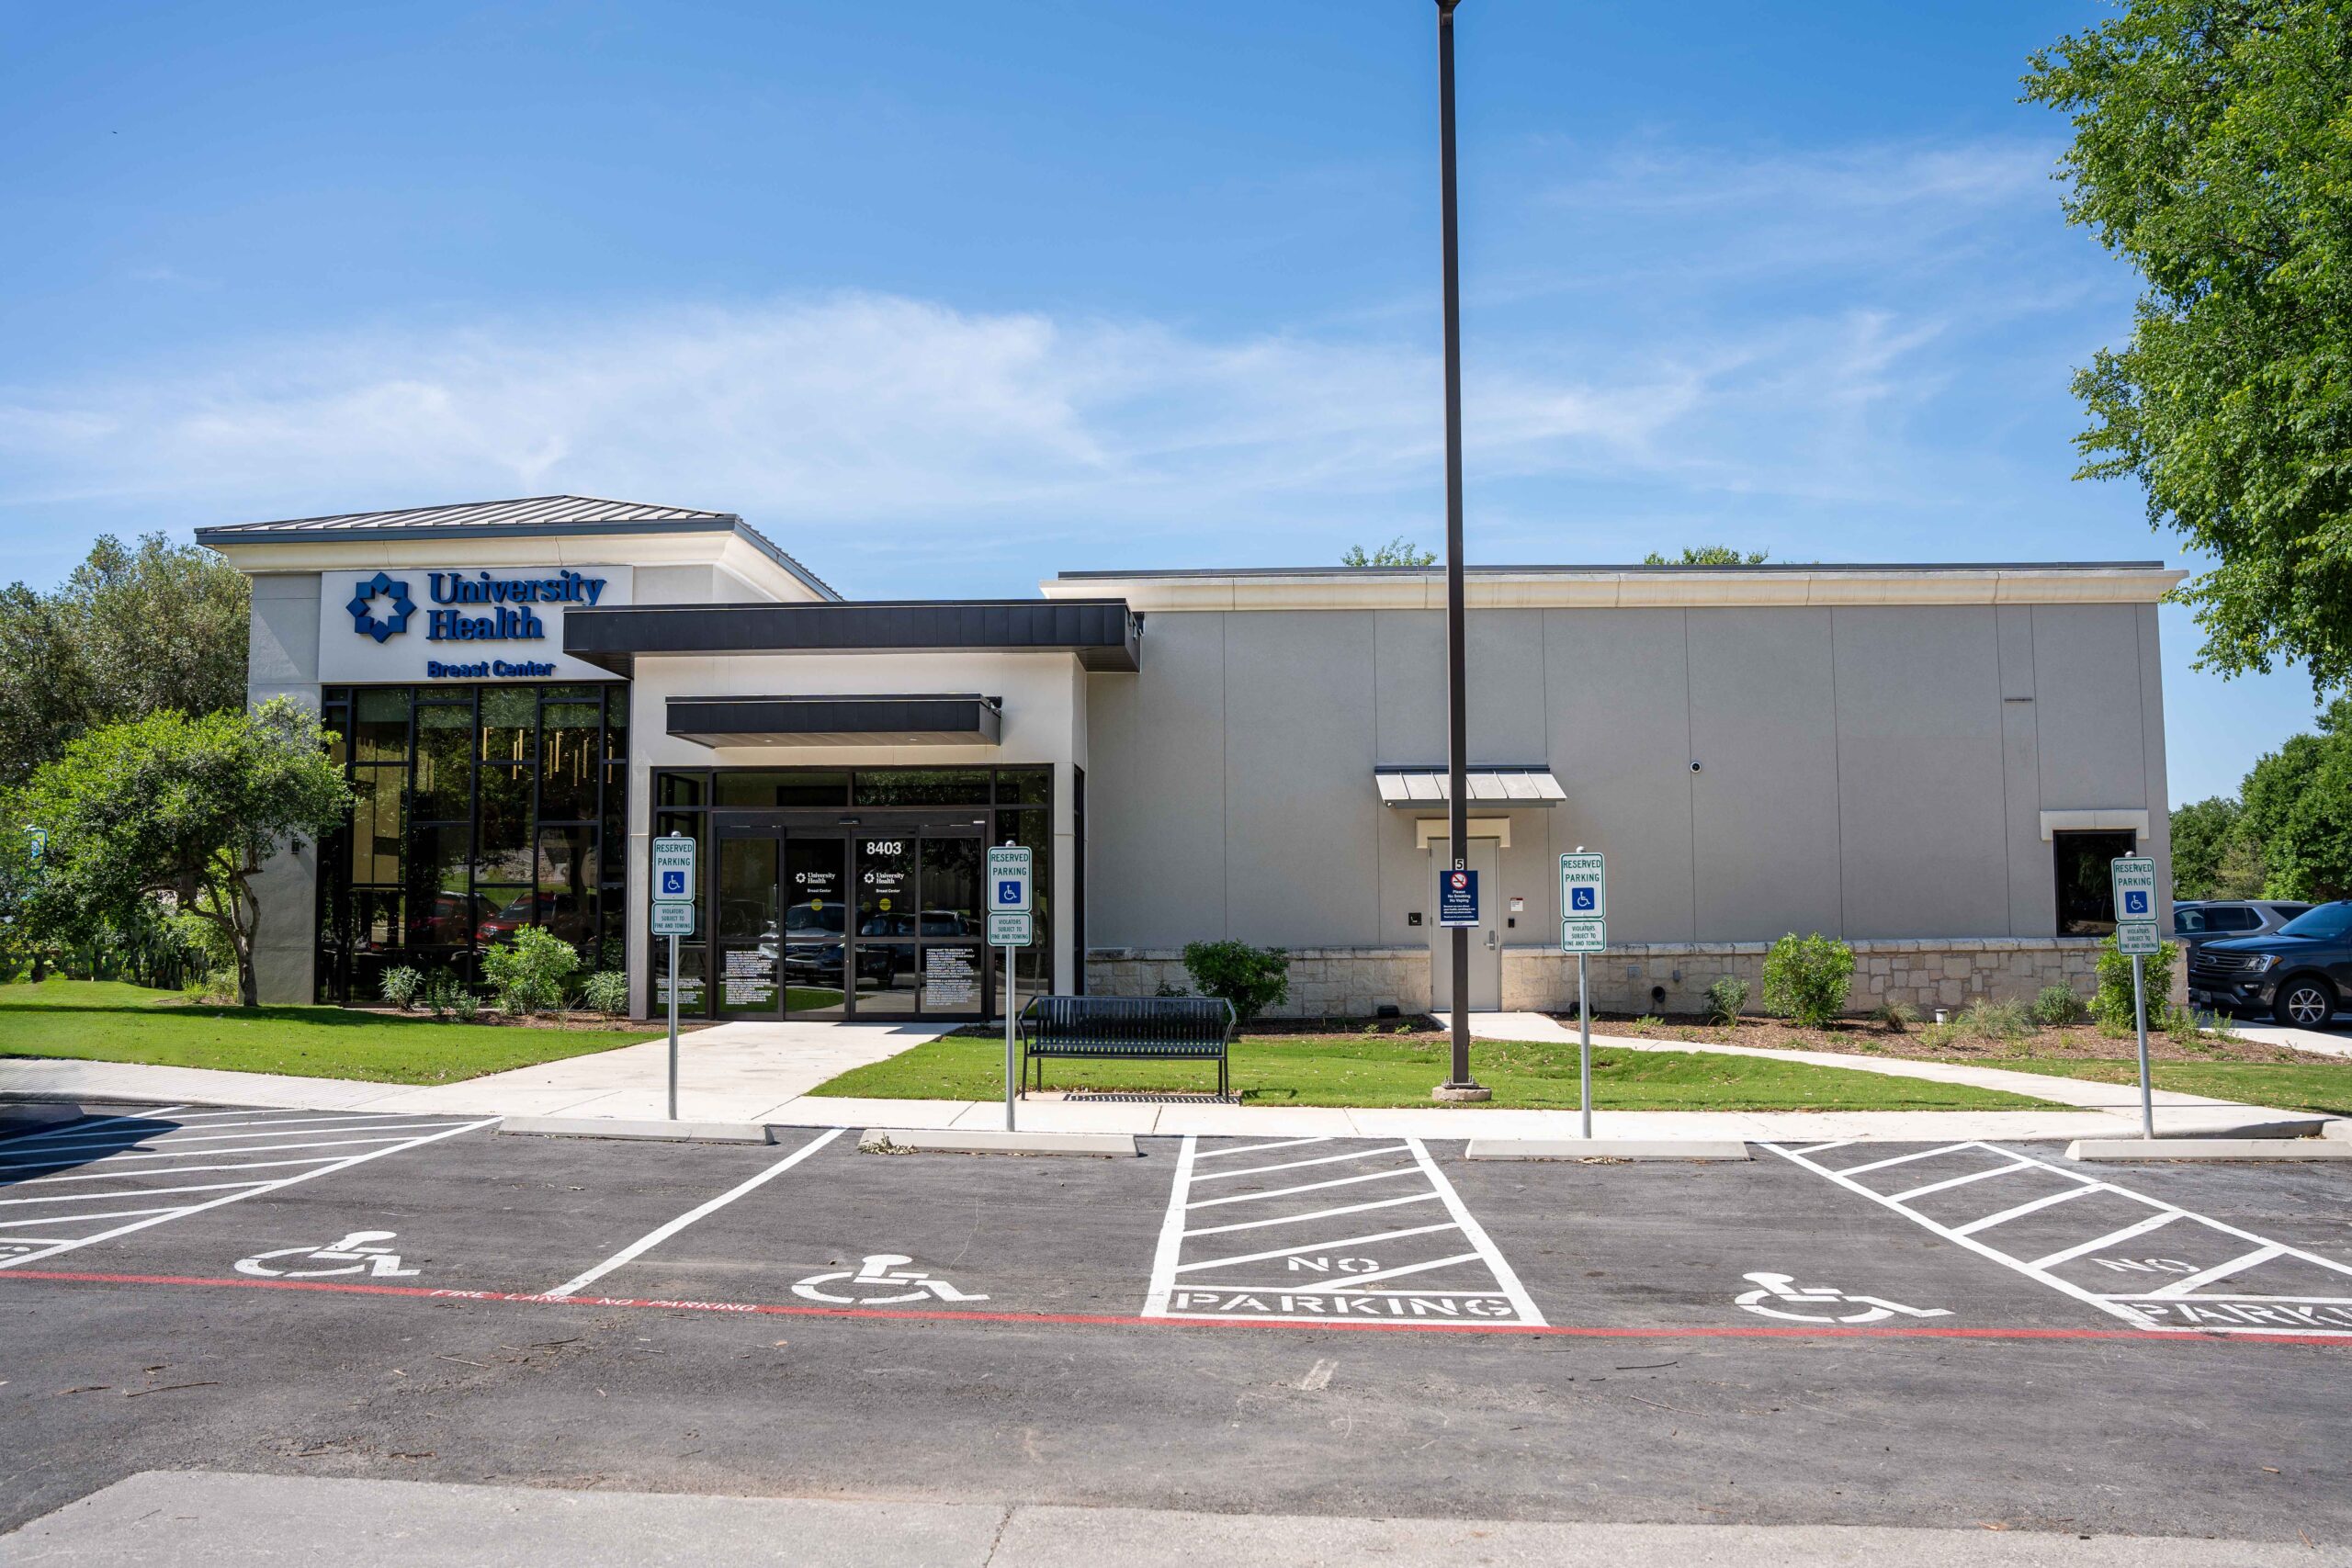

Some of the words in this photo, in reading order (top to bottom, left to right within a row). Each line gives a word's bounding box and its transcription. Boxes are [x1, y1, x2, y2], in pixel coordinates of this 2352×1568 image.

[427, 569, 607, 606] University
[425, 605, 545, 641] Health
[427, 660, 491, 678] Breast
[492, 660, 557, 678] Center
[656, 844, 693, 852] RESERVED
[866, 841, 902, 854] 8403
[657, 858, 691, 866] PARKING
[990, 853, 1029, 863] RESERVED
[1456, 859, 1464, 869] 5
[1563, 860, 1601, 868] RESERVED
[2115, 863, 2153, 873] RESERVED
[992, 867, 1027, 875] PARKING
[1565, 874, 1600, 882] PARKING
[2118, 877, 2152, 886] PARKING
[1287, 1257, 1380, 1273] NO
[2088, 1258, 2201, 1272] NO
[429, 1289, 494, 1299] FIRE
[503, 1292, 577, 1304] LANE
[596, 1297, 634, 1305] NO
[647, 1299, 758, 1312] PARKING
[1175, 1292, 1514, 1317] PARKING
